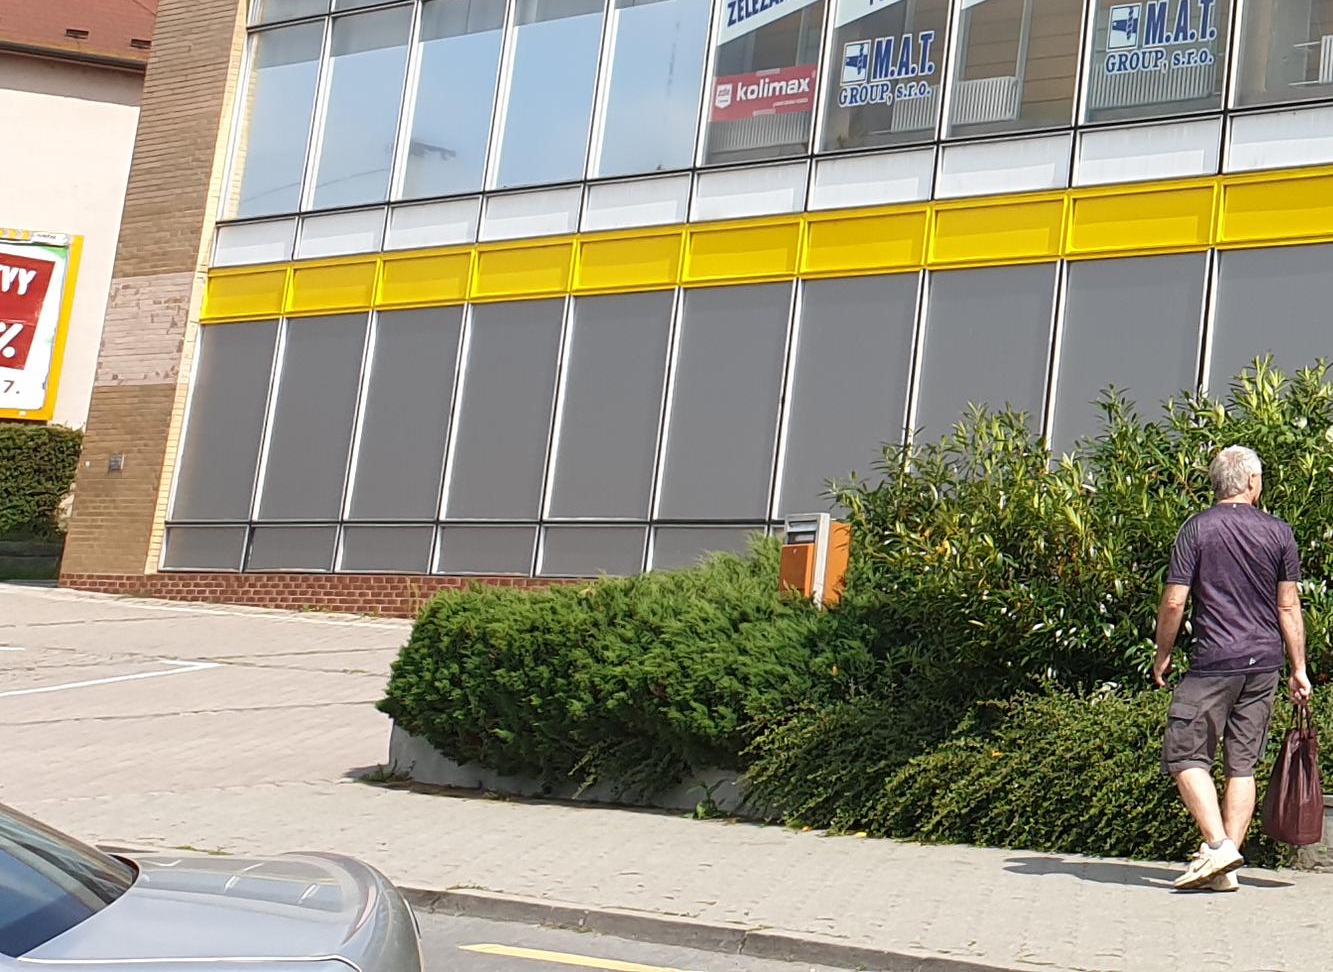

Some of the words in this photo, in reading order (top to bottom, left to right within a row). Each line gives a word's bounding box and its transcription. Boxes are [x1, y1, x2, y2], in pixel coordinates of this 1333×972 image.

[872, 31, 935, 80] M.A.T.
[1105, 49, 1167, 74] GROUP,
[1172, 48, 1214, 68] s.r.o.
[736, 76, 811, 101] kolimax
[839, 83, 893, 106] GROUP,
[896, 81, 932, 101] s.r.o.
[0, 264, 37, 295] VY
